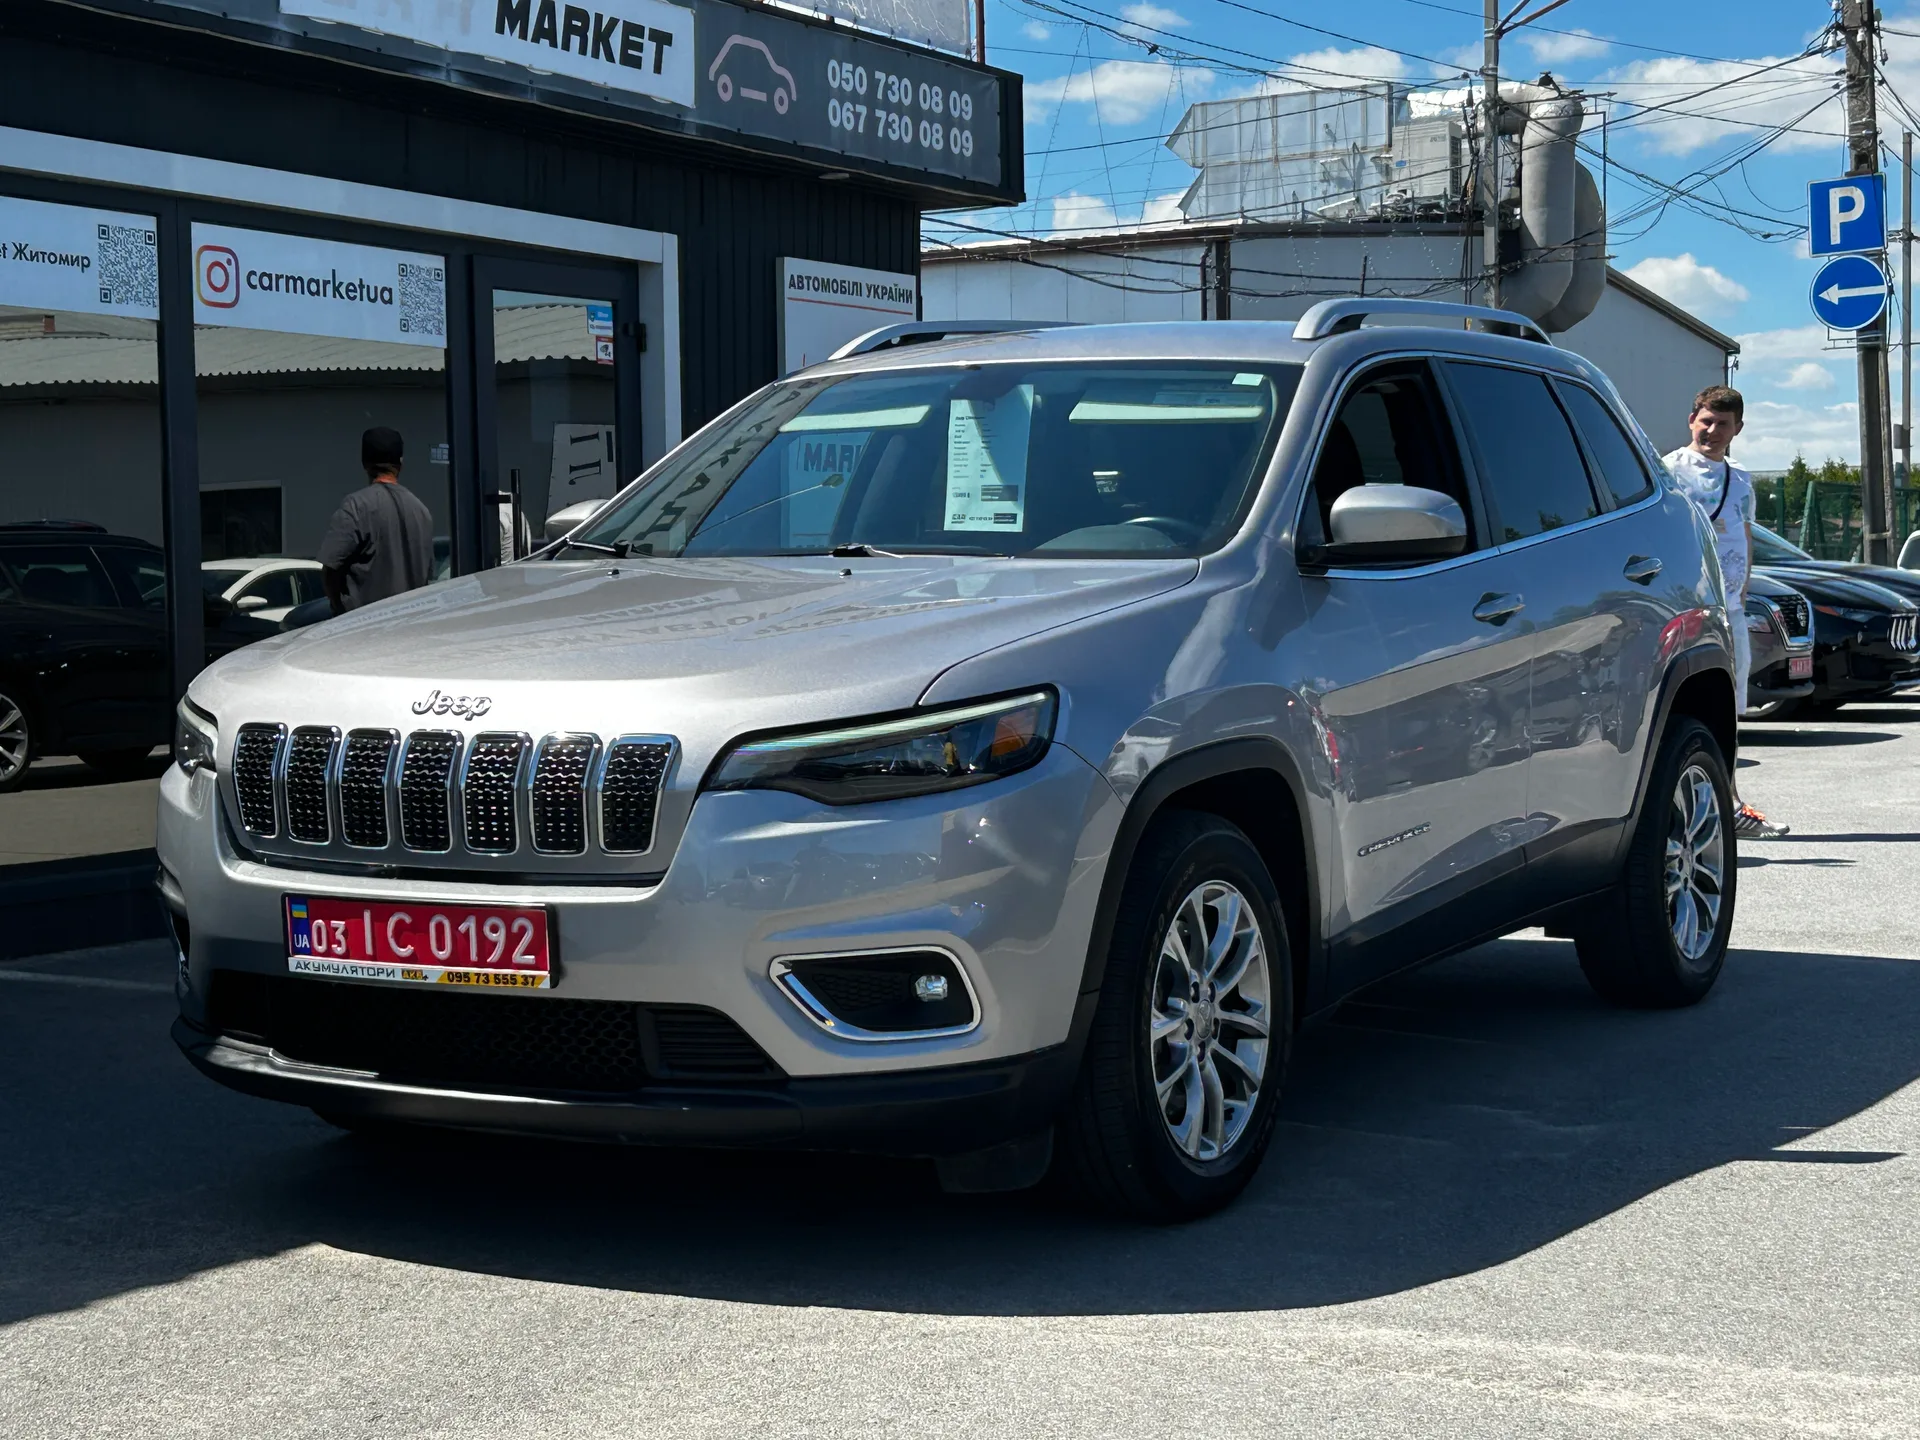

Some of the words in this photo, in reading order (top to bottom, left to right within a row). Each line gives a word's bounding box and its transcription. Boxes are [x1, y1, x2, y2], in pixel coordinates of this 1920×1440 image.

[494, 0, 674, 76] MARKET
[827, 59, 868, 95] 050
[874, 70, 912, 107] 730
[919, 82, 943, 114] 08
[949, 90, 973, 121] 09
[828, 98, 867, 133] 067
[875, 109, 913, 144] 730
[919, 120, 944, 151] 08
[950, 127, 973, 157] 09
[1829, 186, 1865, 246] P
[11, 241, 92, 274] Житомир
[246, 268, 394, 305] carmarketua
[788, 273, 863, 297] АВТОМОБІЛІ
[865, 282, 913, 304] УКРАЇНИ
[411, 689, 493, 722] Jeep
[294, 934, 310, 949] UA
[311, 919, 347, 956] 03
[428, 912, 536, 966] 0192
[294, 960, 396, 978] АКУМУЛЯТОРИ
[447, 971, 471, 983] 095
[475, 972, 490, 984] 73
[520, 974, 537, 987] 37
